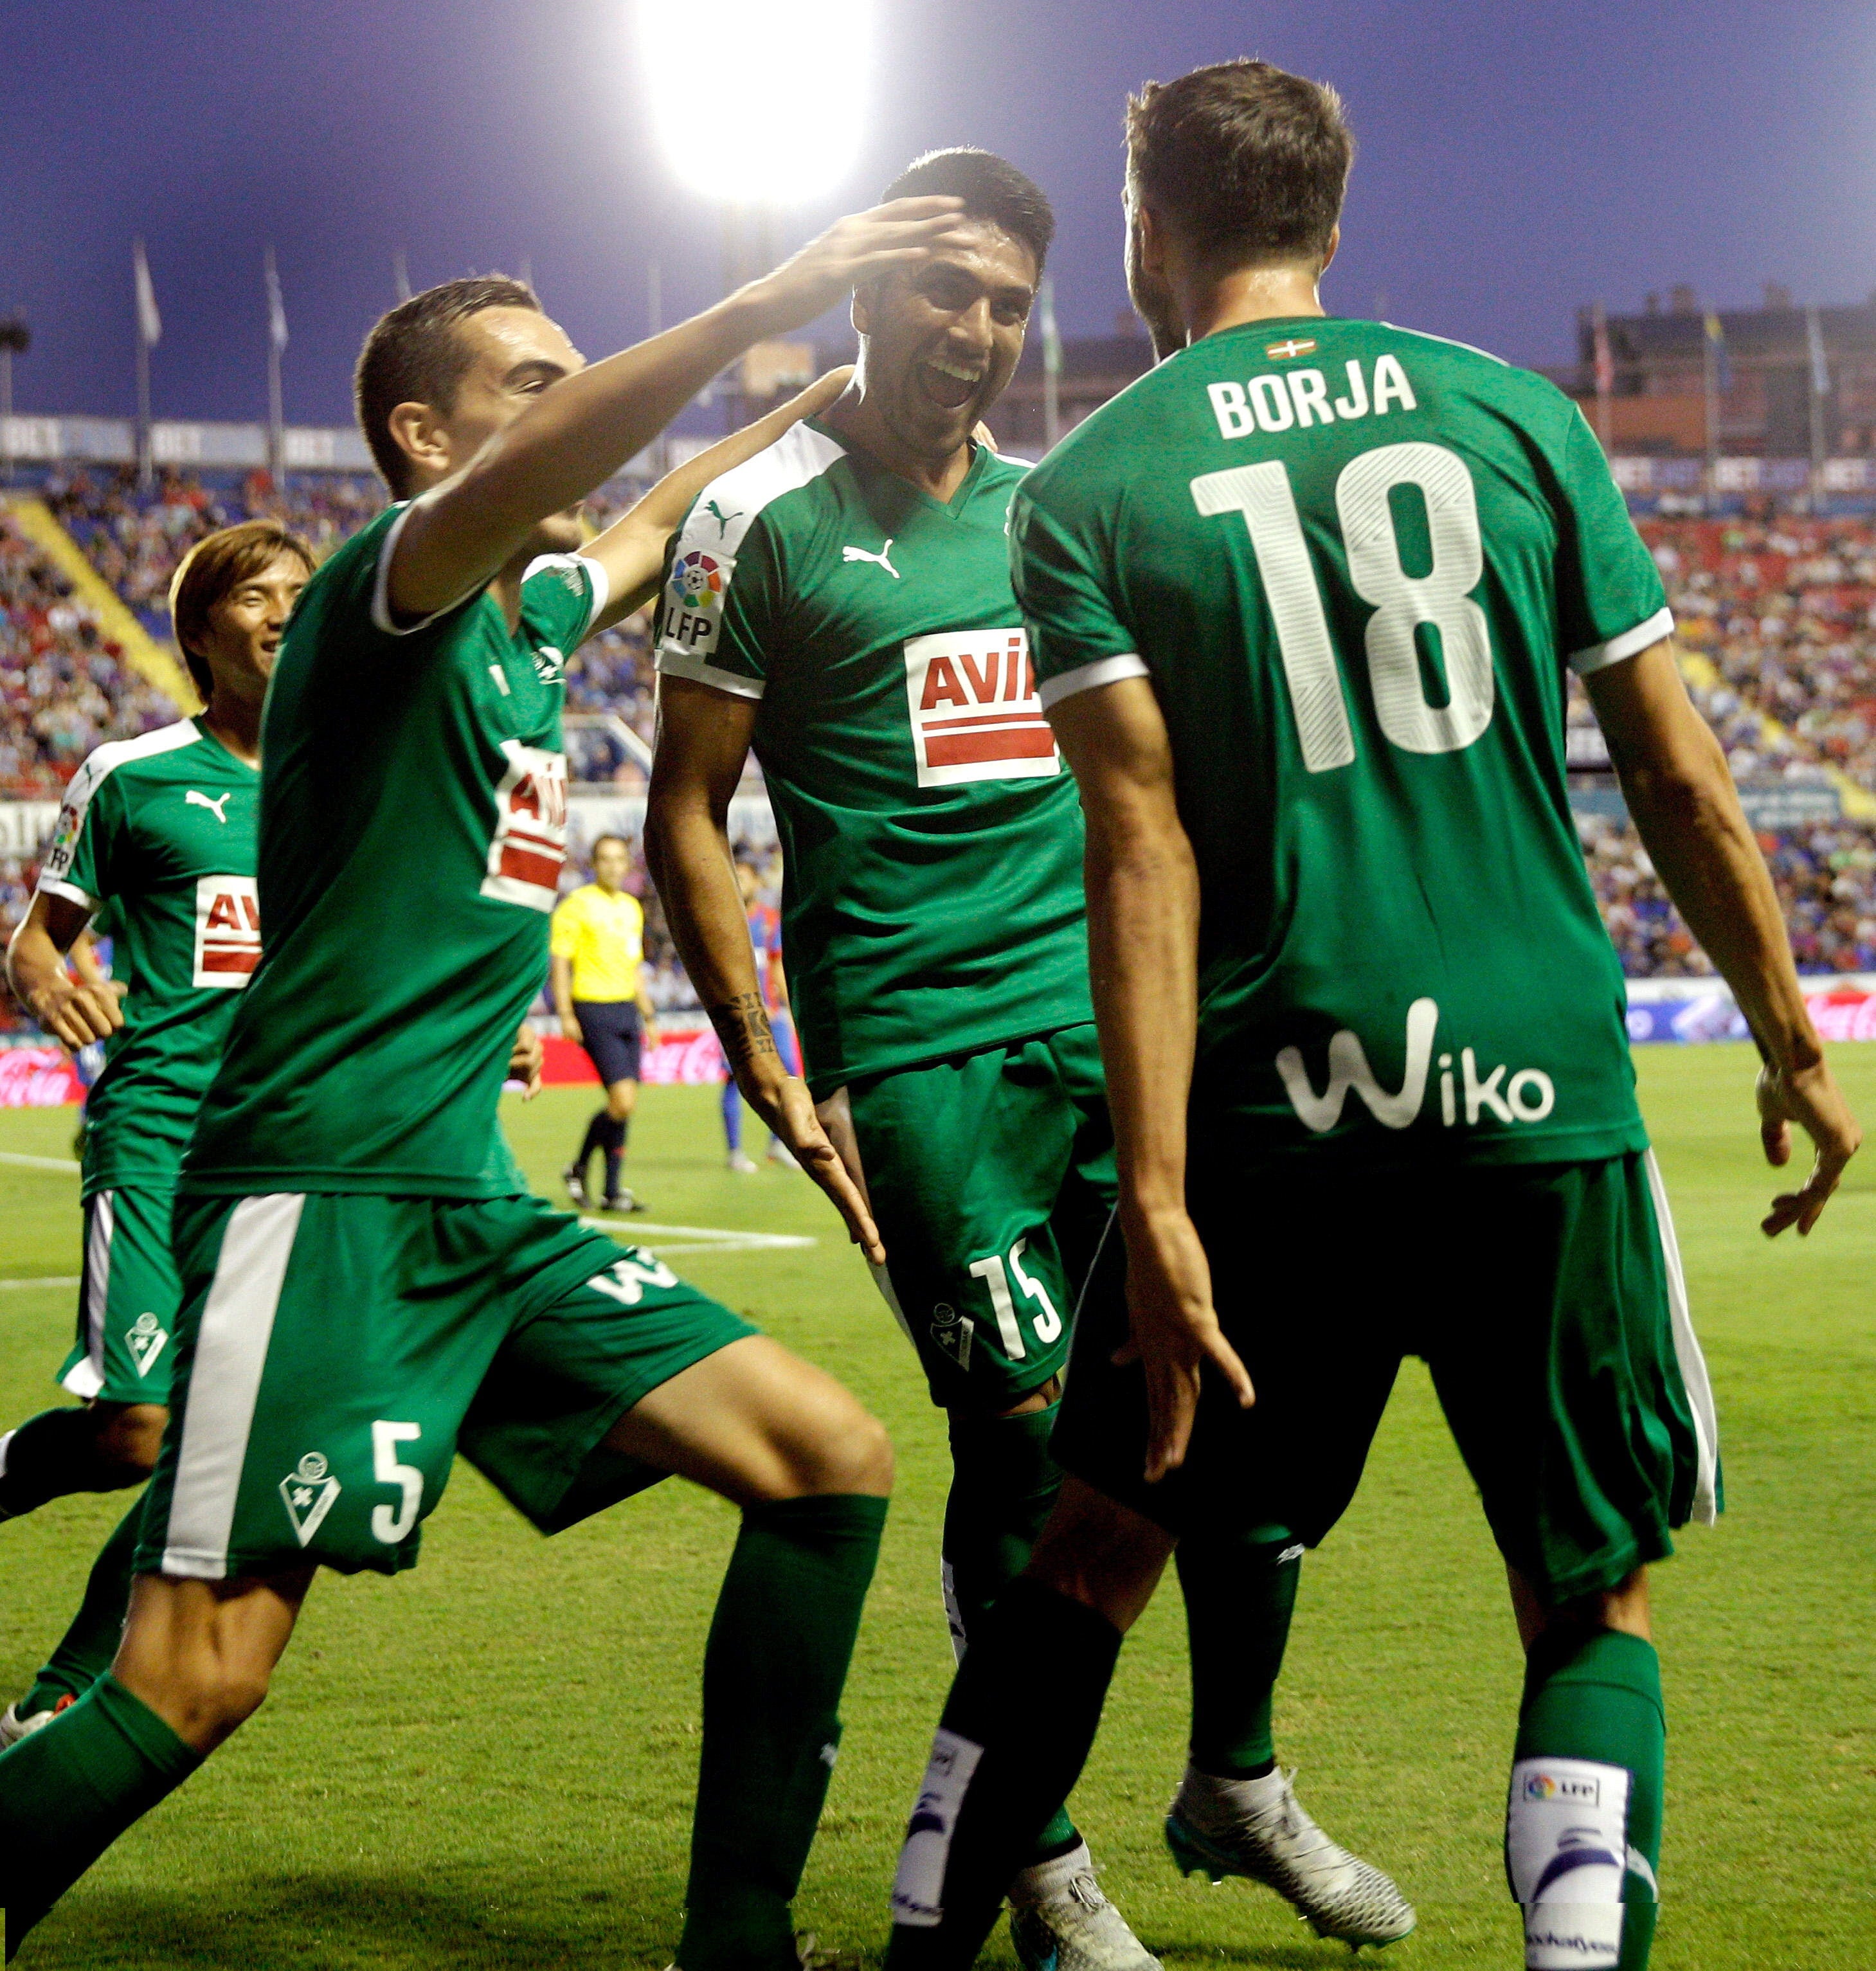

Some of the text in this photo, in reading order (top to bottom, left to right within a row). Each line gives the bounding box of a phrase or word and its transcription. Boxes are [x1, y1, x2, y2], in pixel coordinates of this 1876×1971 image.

[1207, 354, 1417, 440] BORJA
[665, 606, 712, 646] LFP
[1189, 442, 1495, 774] 18
[1276, 996, 1555, 1133] Wiko
[969, 1237, 1062, 1361] 15
[370, 1419, 424, 1544] 5
